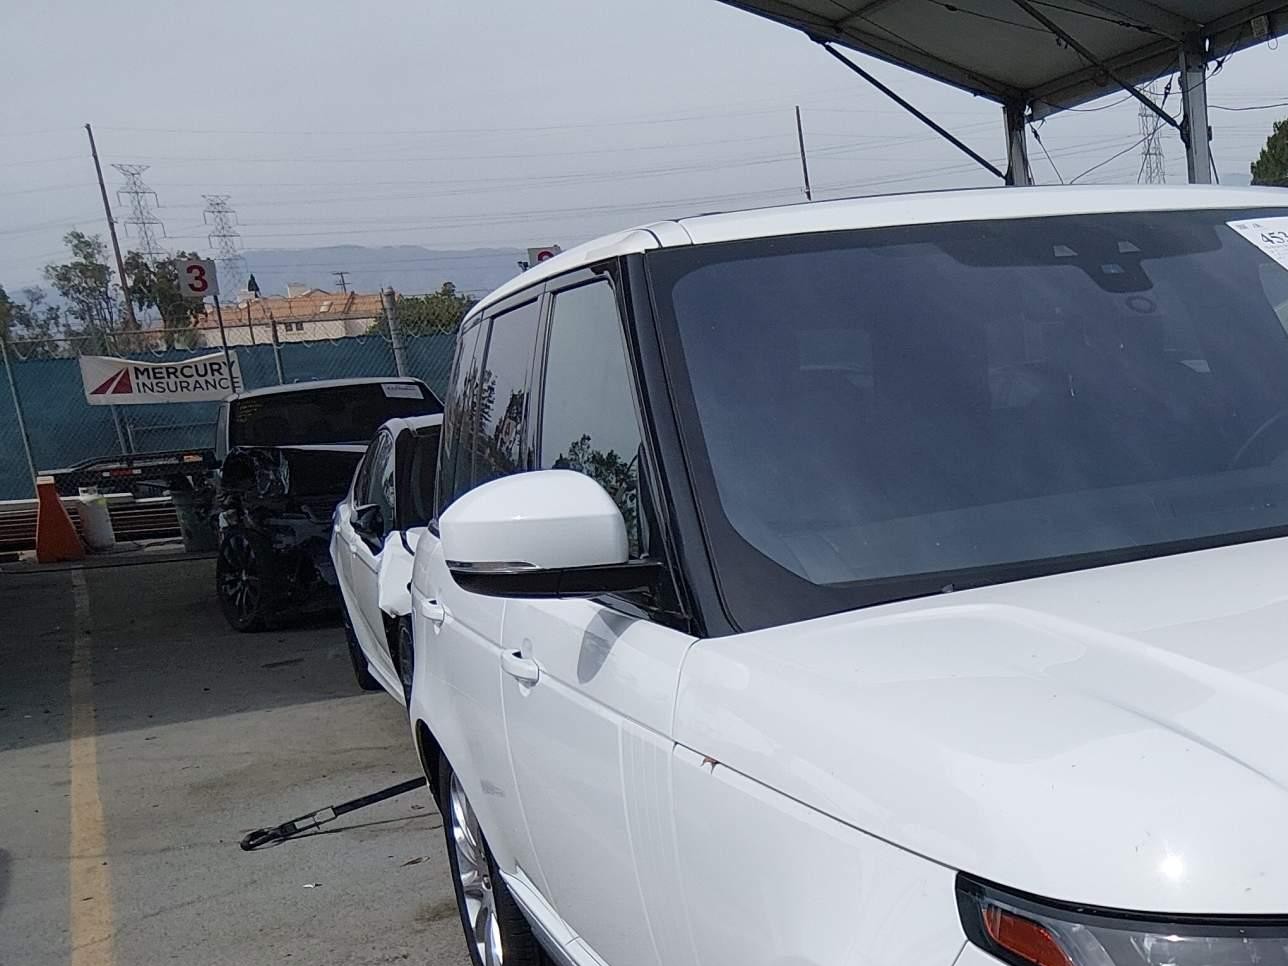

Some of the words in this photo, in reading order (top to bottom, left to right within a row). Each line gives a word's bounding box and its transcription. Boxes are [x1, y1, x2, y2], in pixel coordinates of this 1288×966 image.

[187, 264, 208, 292] 3
[134, 361, 235, 380] MERCURY
[136, 377, 241, 394] INSURANCE
